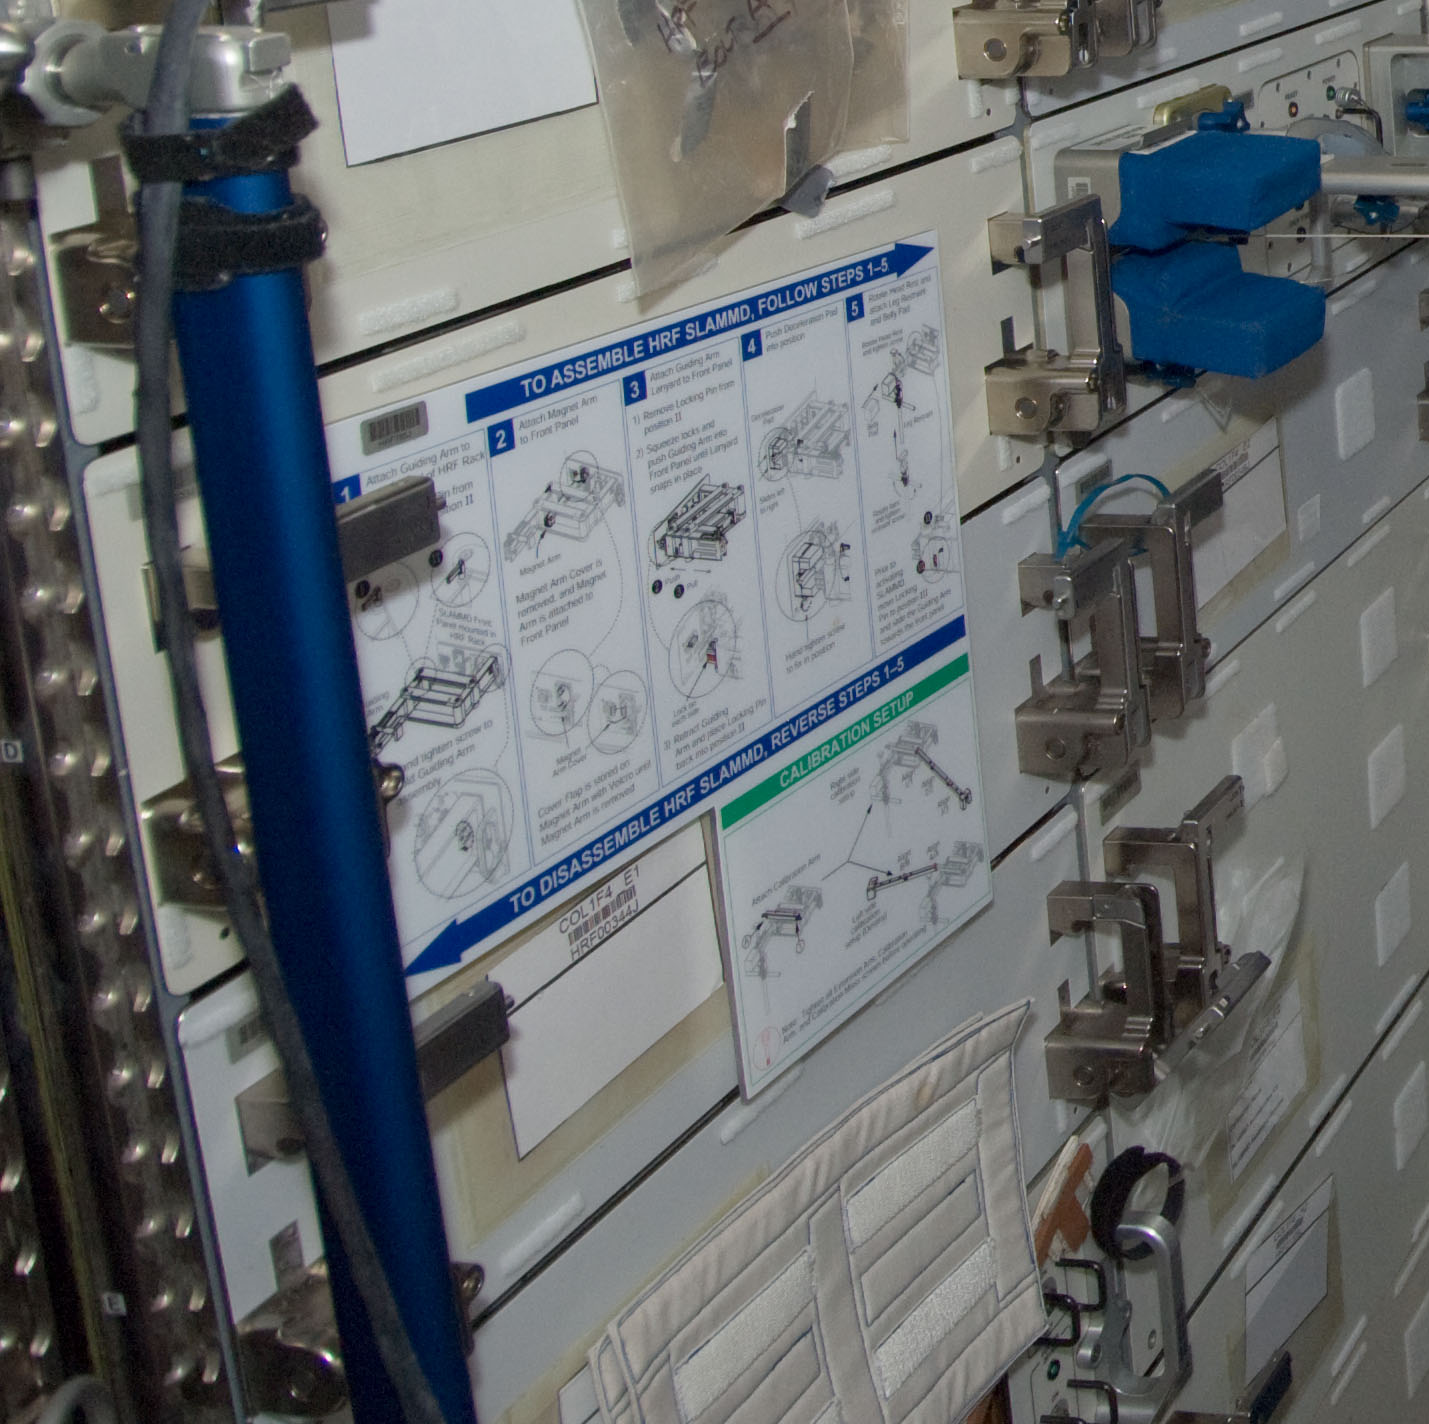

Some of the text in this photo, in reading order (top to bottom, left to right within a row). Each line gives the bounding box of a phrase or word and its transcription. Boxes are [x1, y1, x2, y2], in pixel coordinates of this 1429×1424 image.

[850, 300, 859, 317] 5
[520, 378, 547, 399] TO
[550, 341, 645, 391] ASSEMBLE
[648, 327, 682, 354] HRF
[684, 299, 756, 341] SLAMMD,
[757, 280, 818, 318] FOLLOW
[820, 266, 864, 295] STEPS
[747, 337, 756, 354] 4
[629, 358, 704, 399] 3 Guiding
[691, 357, 733, 383] Front Panel
[642, 389, 705, 422] Remove Locking
[495, 401, 578, 450] 2 Attach Magnet
[530, 415, 579, 443] Front Panel
[643, 416, 674, 436] position
[462, 451, 485, 466] Rack
[646, 434, 681, 457] Squeeze
[648, 436, 739, 481] Front Panel Lanyard
[667, 441, 697, 461] Guiding
[366, 465, 398, 487] Attach
[399, 450, 437, 477] Guiding
[439, 444, 460, 463] Arm
[516, 562, 594, 604] Magnet Cover
[548, 598, 585, 620] attached
[520, 615, 570, 647] Front Panel
[779, 690, 915, 789] CALIBRATION SETUP
[509, 889, 537, 916] TO
[538, 810, 662, 898] DISASSEMBLE
[662, 789, 698, 820] HRF
[699, 744, 768, 796] SLAMMD,
[770, 698, 836, 750] REVERSE
[838, 671, 881, 709] STEPS
[570, 902, 640, 963] HRF00344J
